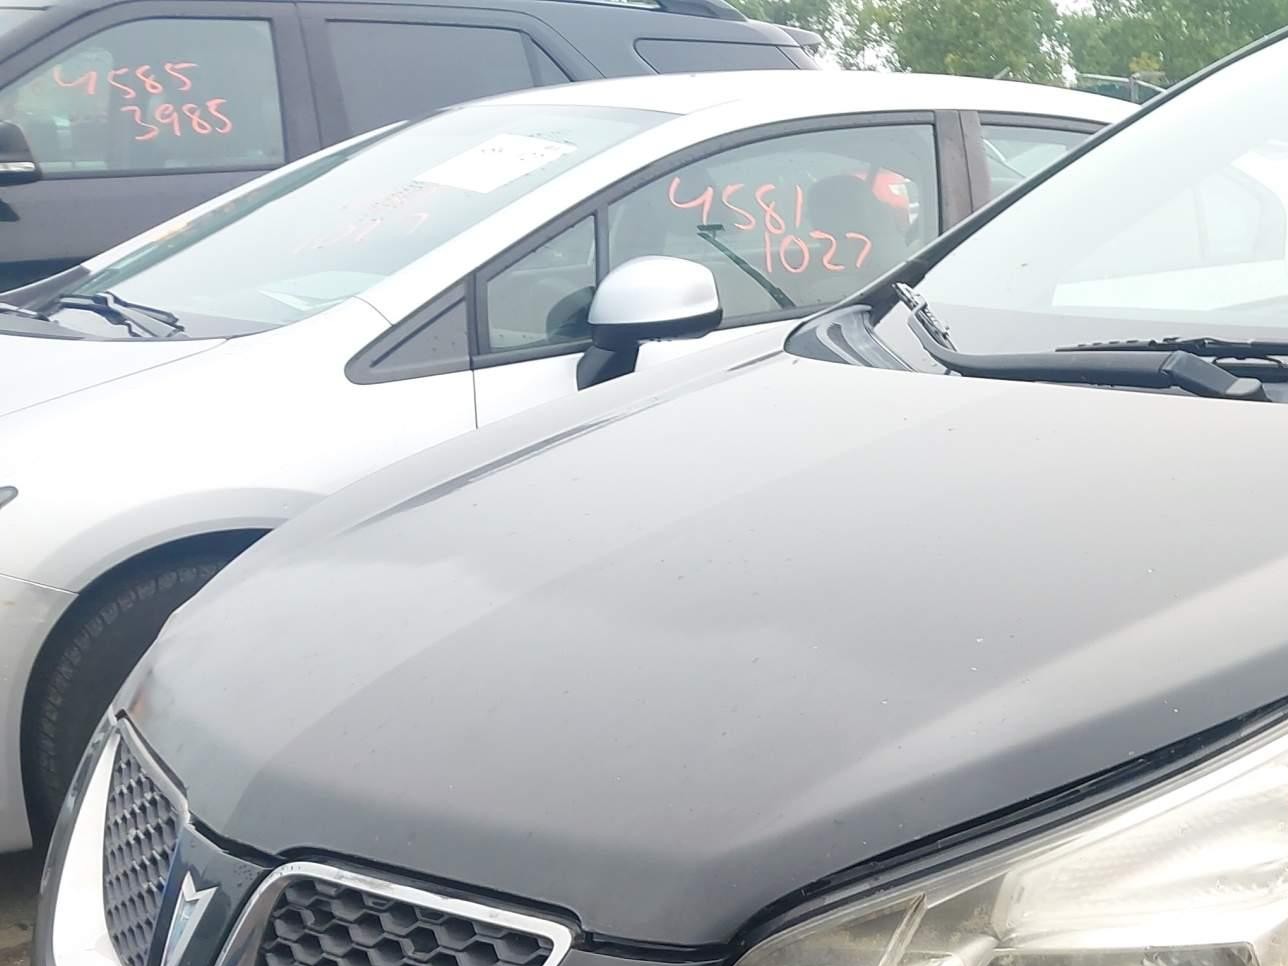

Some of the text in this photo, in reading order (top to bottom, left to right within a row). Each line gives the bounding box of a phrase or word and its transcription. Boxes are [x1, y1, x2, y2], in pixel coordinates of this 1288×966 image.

[52, 62, 199, 99] 4585
[119, 98, 233, 140] 3985
[668, 176, 803, 235] 4581
[763, 229, 873, 273] 1027
